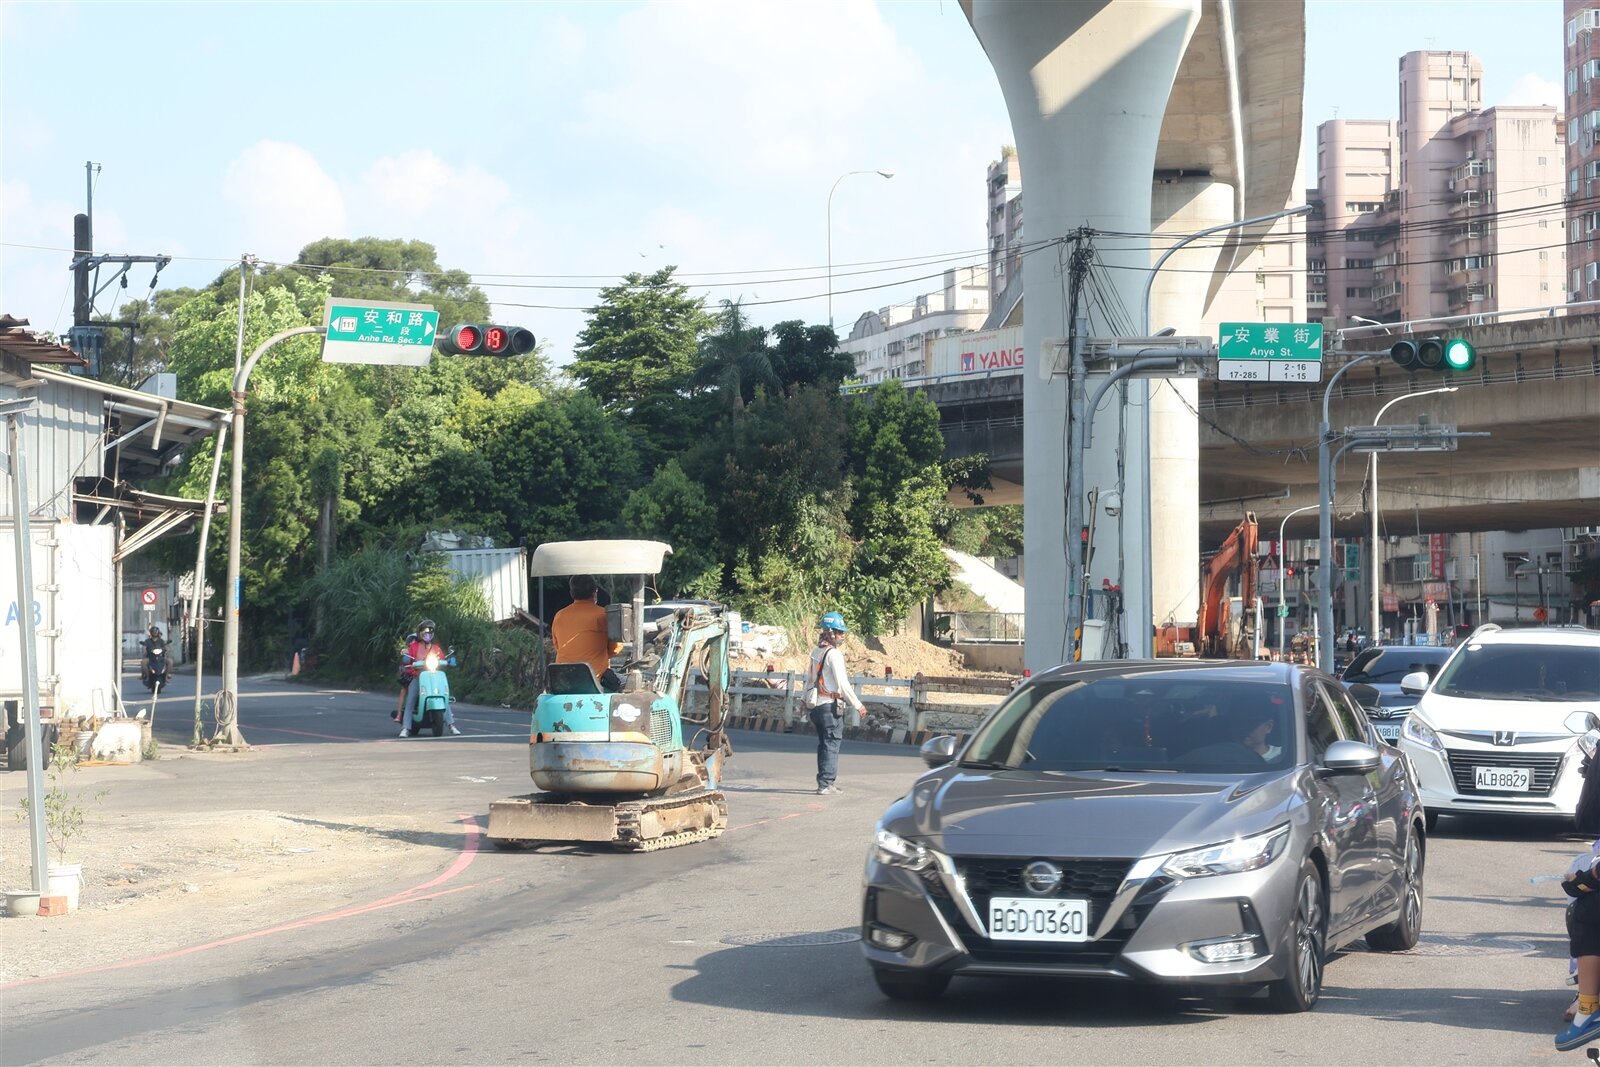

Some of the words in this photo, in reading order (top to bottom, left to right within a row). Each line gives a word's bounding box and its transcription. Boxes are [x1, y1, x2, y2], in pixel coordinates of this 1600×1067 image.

[364, 309, 424, 326] 安和路
[358, 334, 380, 342] Anhe
[382, 335, 396, 343] Rd.
[397, 336, 415, 344] Sec.
[1235, 326, 1310, 344] 安業街
[979, 347, 1024, 370] YANG
[1250, 347, 1275, 358] Anye
[1280, 347, 1294, 357] St.
[1230, 371, 1258, 379] 17-285
